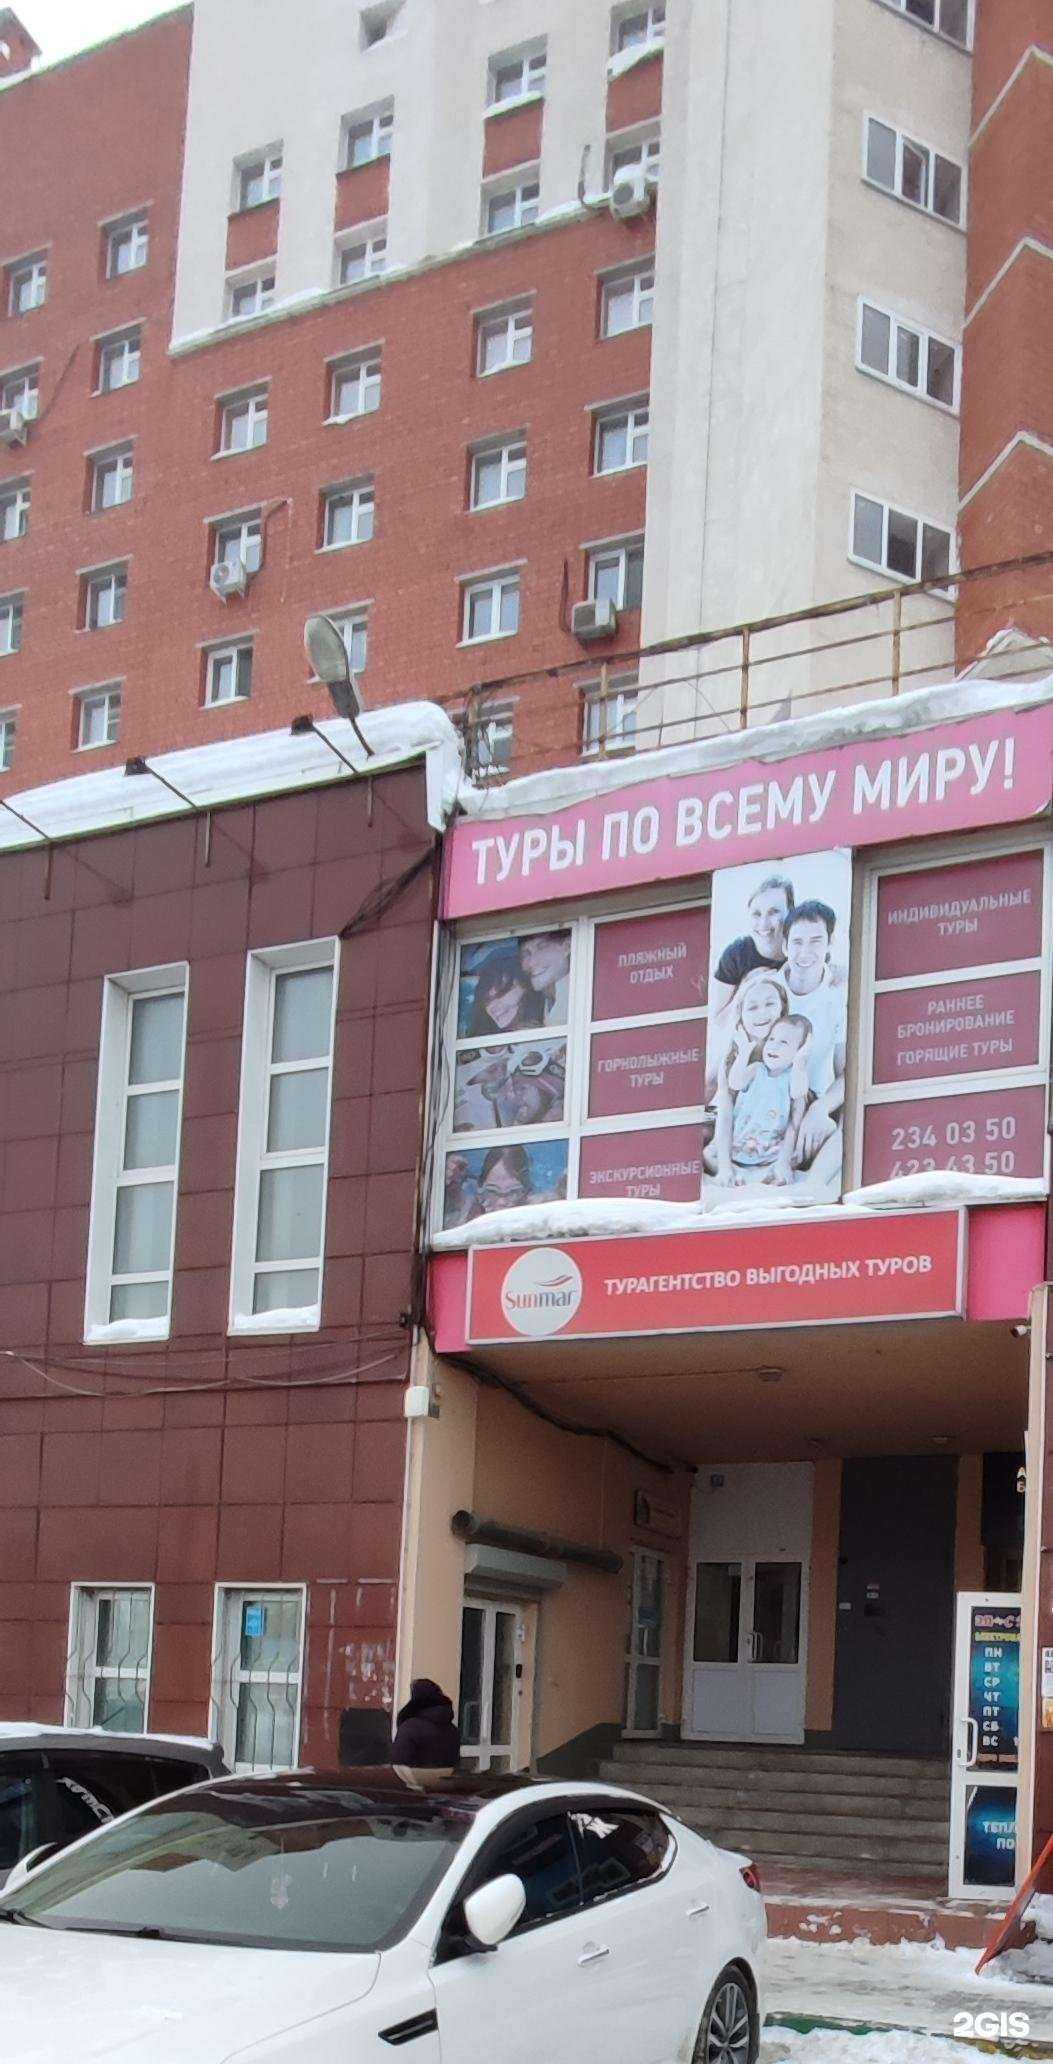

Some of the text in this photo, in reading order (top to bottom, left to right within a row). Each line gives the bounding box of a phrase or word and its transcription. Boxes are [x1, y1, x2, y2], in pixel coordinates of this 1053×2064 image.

[472, 737, 1015, 885] ТУРЫ ПО ВСЕМУ МИРУ!
[888, 888, 1032, 925] ИНДИВИДУАЛЬНЫЕ
[937, 918, 978, 936] ТУРЫ
[618, 942, 687, 967] ПЛЯЖНЫЙ
[630, 965, 674, 984] ОТДЫХ
[928, 994, 985, 1014] РАННЕЕ
[897, 1010, 1016, 1039] БРОНИРОВАНИЕ
[598, 1048, 700, 1072] ГОРНОЛЫЖНЫЕ
[897, 1038, 1013, 1066] ГОРЯЩИЕ ТУРЫ
[630, 1071, 664, 1088] ТУРЫ
[891, 1116, 1016, 1150] 234 03 50
[589, 1161, 700, 1185] ЭКСКУРСИОННЫЕ
[984, 1150, 1015, 1175] 50
[625, 1183, 661, 1198] ТУРЫ
[604, 1255, 933, 1296] ТУРАГЕНТСТВО ВЫГОДНЫХ ТУРОВ
[505, 1288, 577, 1311] Sunmar
[984, 1647, 1003, 1659] ПН
[984, 1662, 1001, 1674] ВТ
[983, 1676, 1001, 1689] СР
[983, 1691, 1001, 1702] ЧТ
[982, 1705, 1000, 1717] ПТ
